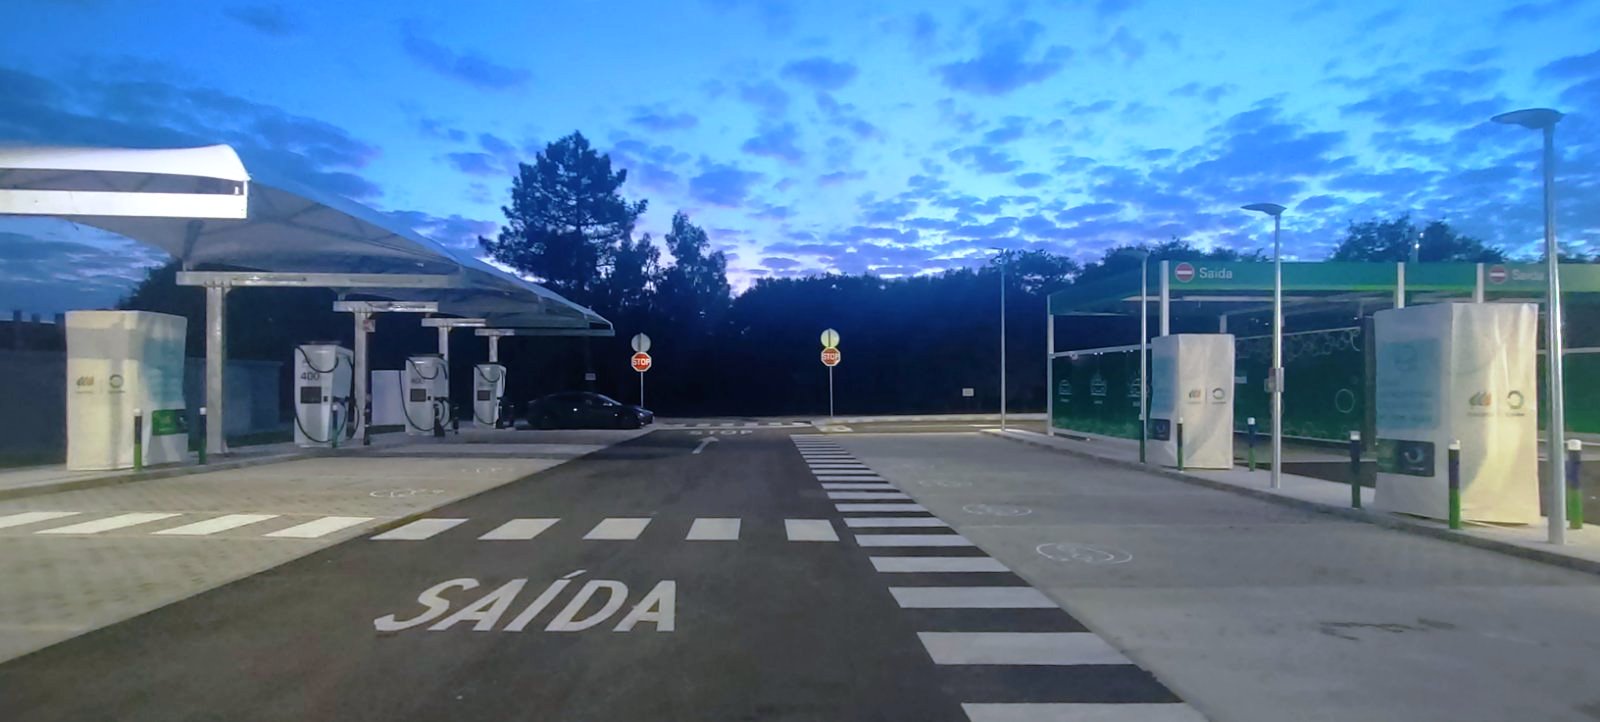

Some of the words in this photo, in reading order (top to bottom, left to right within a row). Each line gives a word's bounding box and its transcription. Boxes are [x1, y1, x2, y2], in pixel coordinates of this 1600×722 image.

[823, 352, 839, 361] STOP
[632, 358, 650, 366] STOP
[300, 371, 320, 381] 400
[374, 569, 677, 632] SAÍDA
